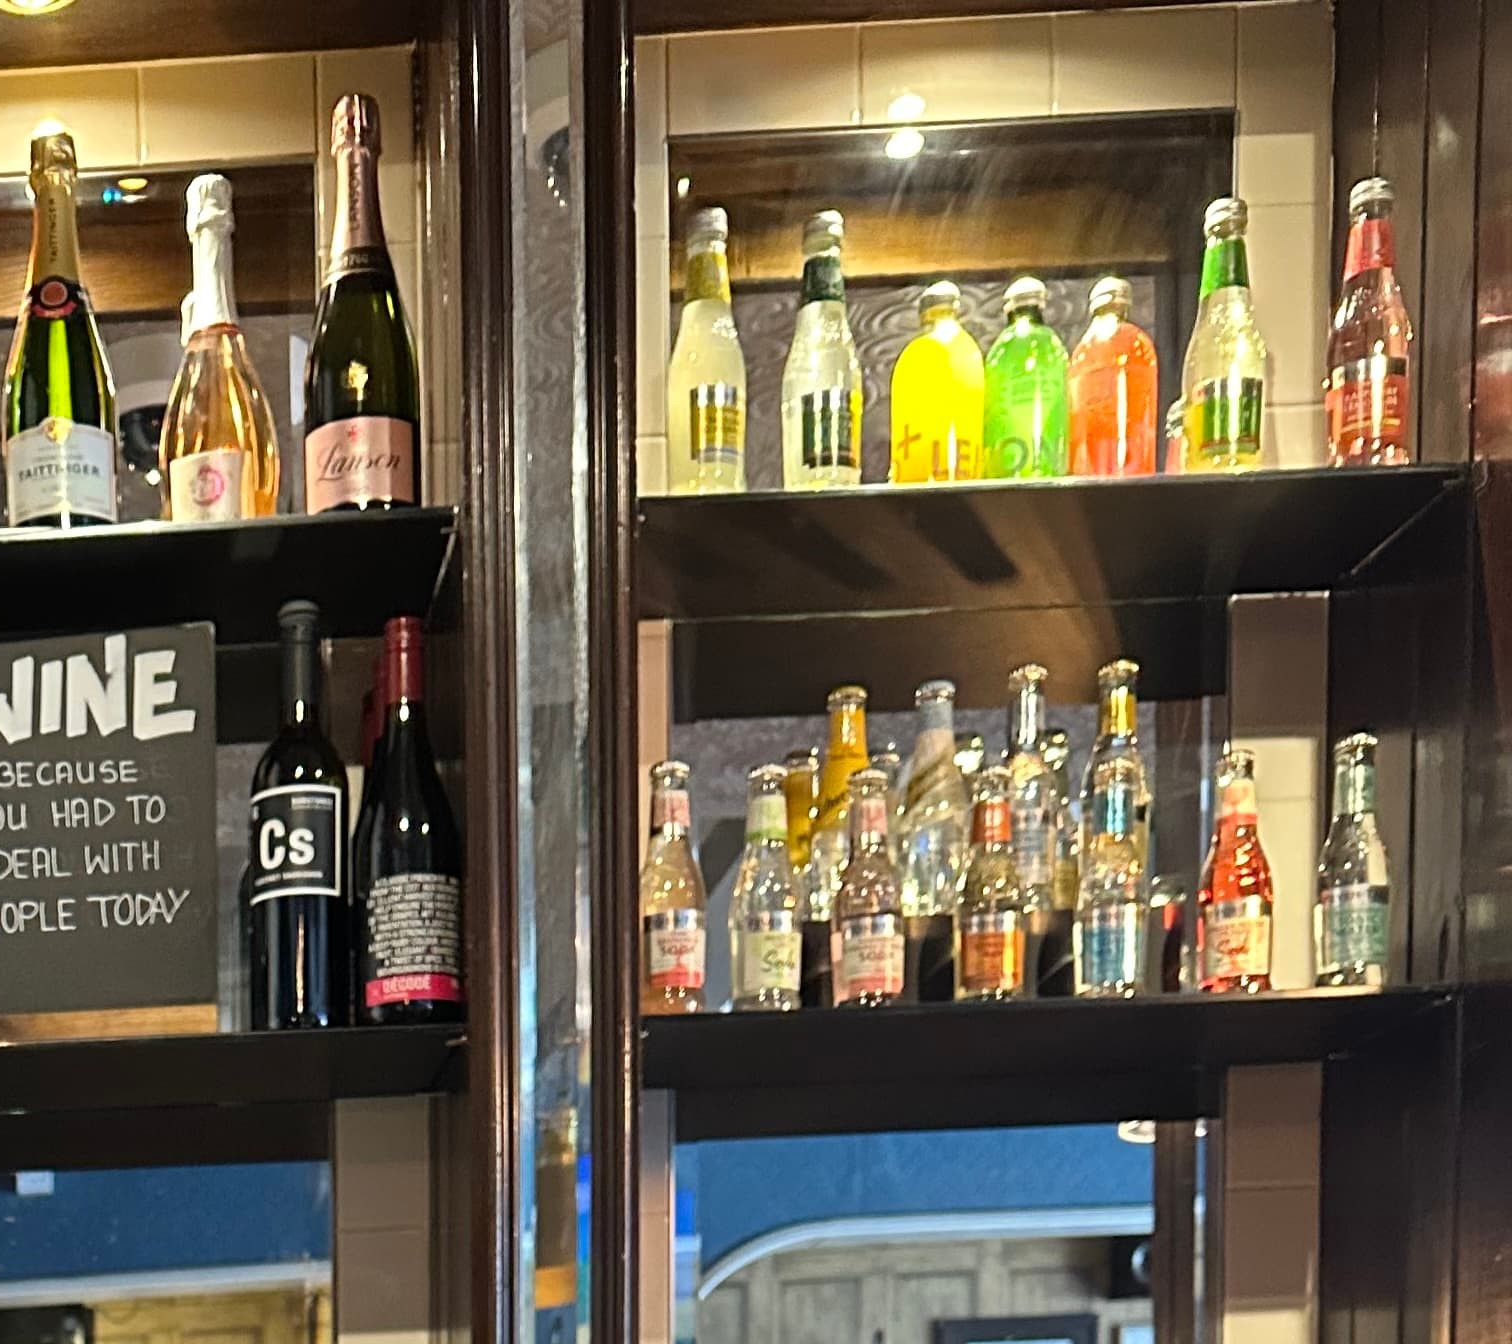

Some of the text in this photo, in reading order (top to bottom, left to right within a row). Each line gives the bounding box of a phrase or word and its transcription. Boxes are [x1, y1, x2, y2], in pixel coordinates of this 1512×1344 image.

[315, 441, 400, 482] Lanson
[51, 797, 116, 828] HAD
[126, 795, 167, 824] TO
[85, 840, 161, 874] WITH
[259, 818, 315, 870] Cs
[87, 888, 190, 928] TODAY
